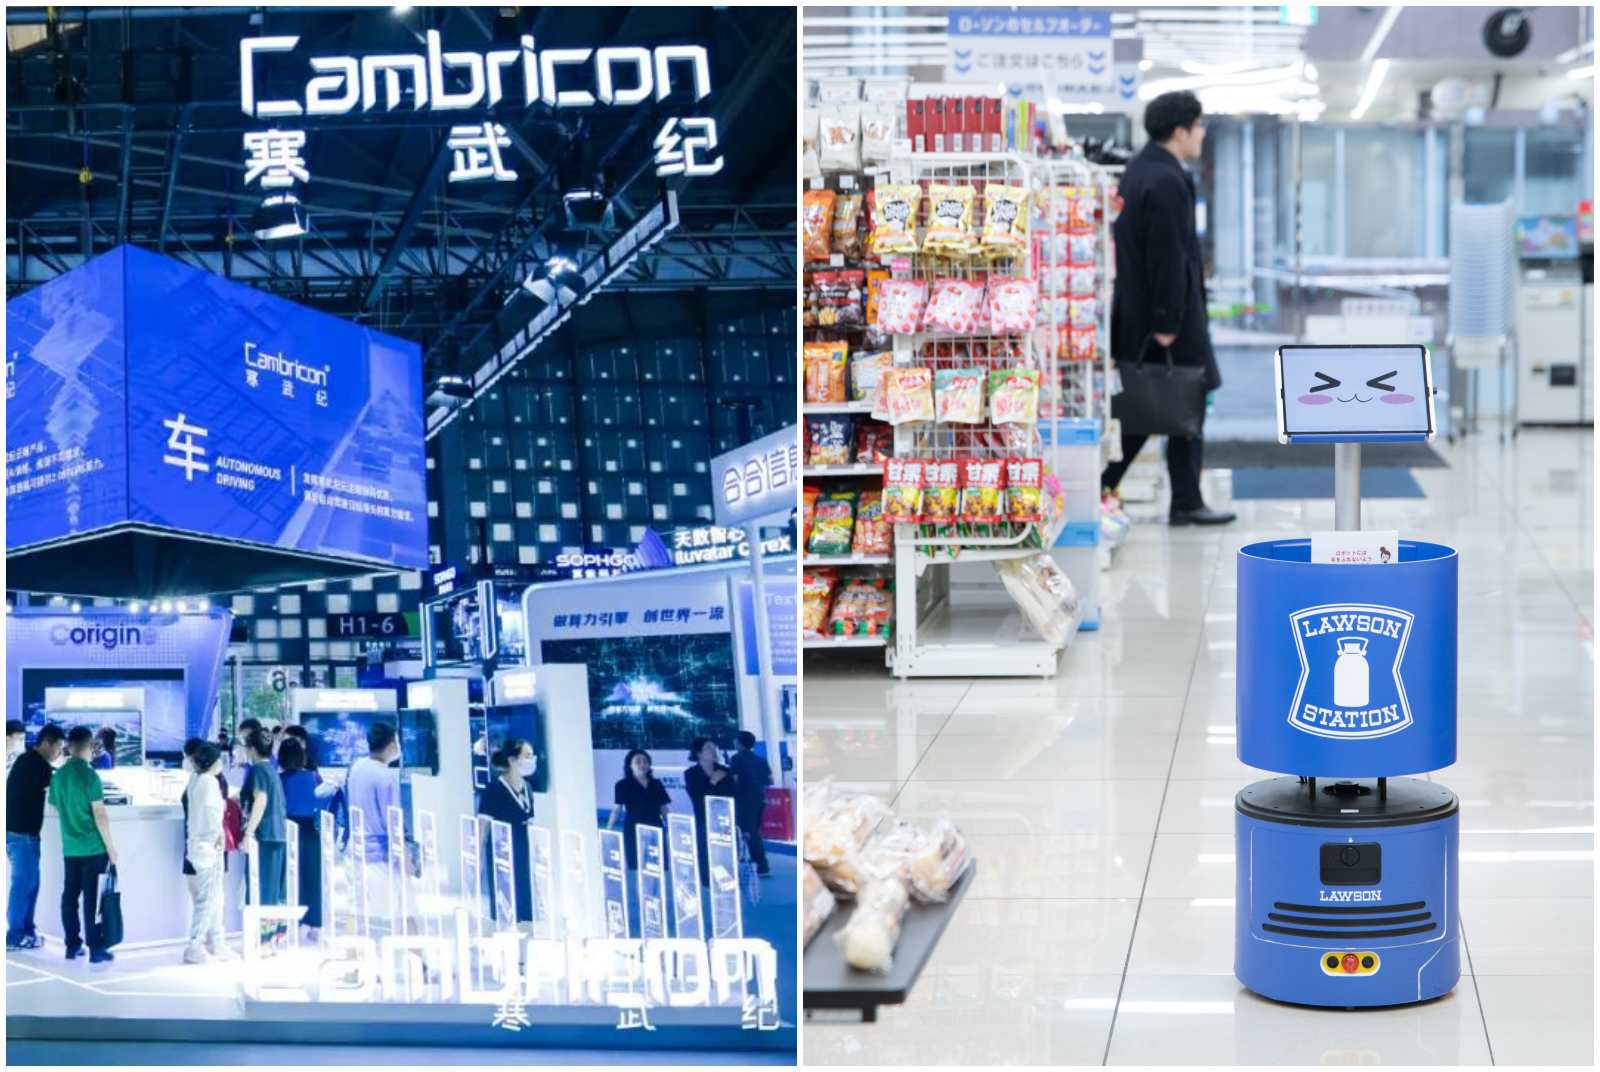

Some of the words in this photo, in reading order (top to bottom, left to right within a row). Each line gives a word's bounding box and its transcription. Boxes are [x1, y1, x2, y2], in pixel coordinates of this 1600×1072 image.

[240, 28, 711, 118] Cambricon
[244, 117, 724, 187] 寒武纪
[244, 341, 328, 388] Cambricon
[163, 412, 210, 482] 车
[215, 456, 282, 481] AUTONOMOUS
[215, 472, 256, 492] DRIVING
[737, 535, 791, 559] CreX
[340, 616, 395, 635] H1-6
[1302, 614, 1402, 639] LAWSON
[1302, 703, 1400, 728] STATION
[1319, 890, 1382, 902] LAWSON
